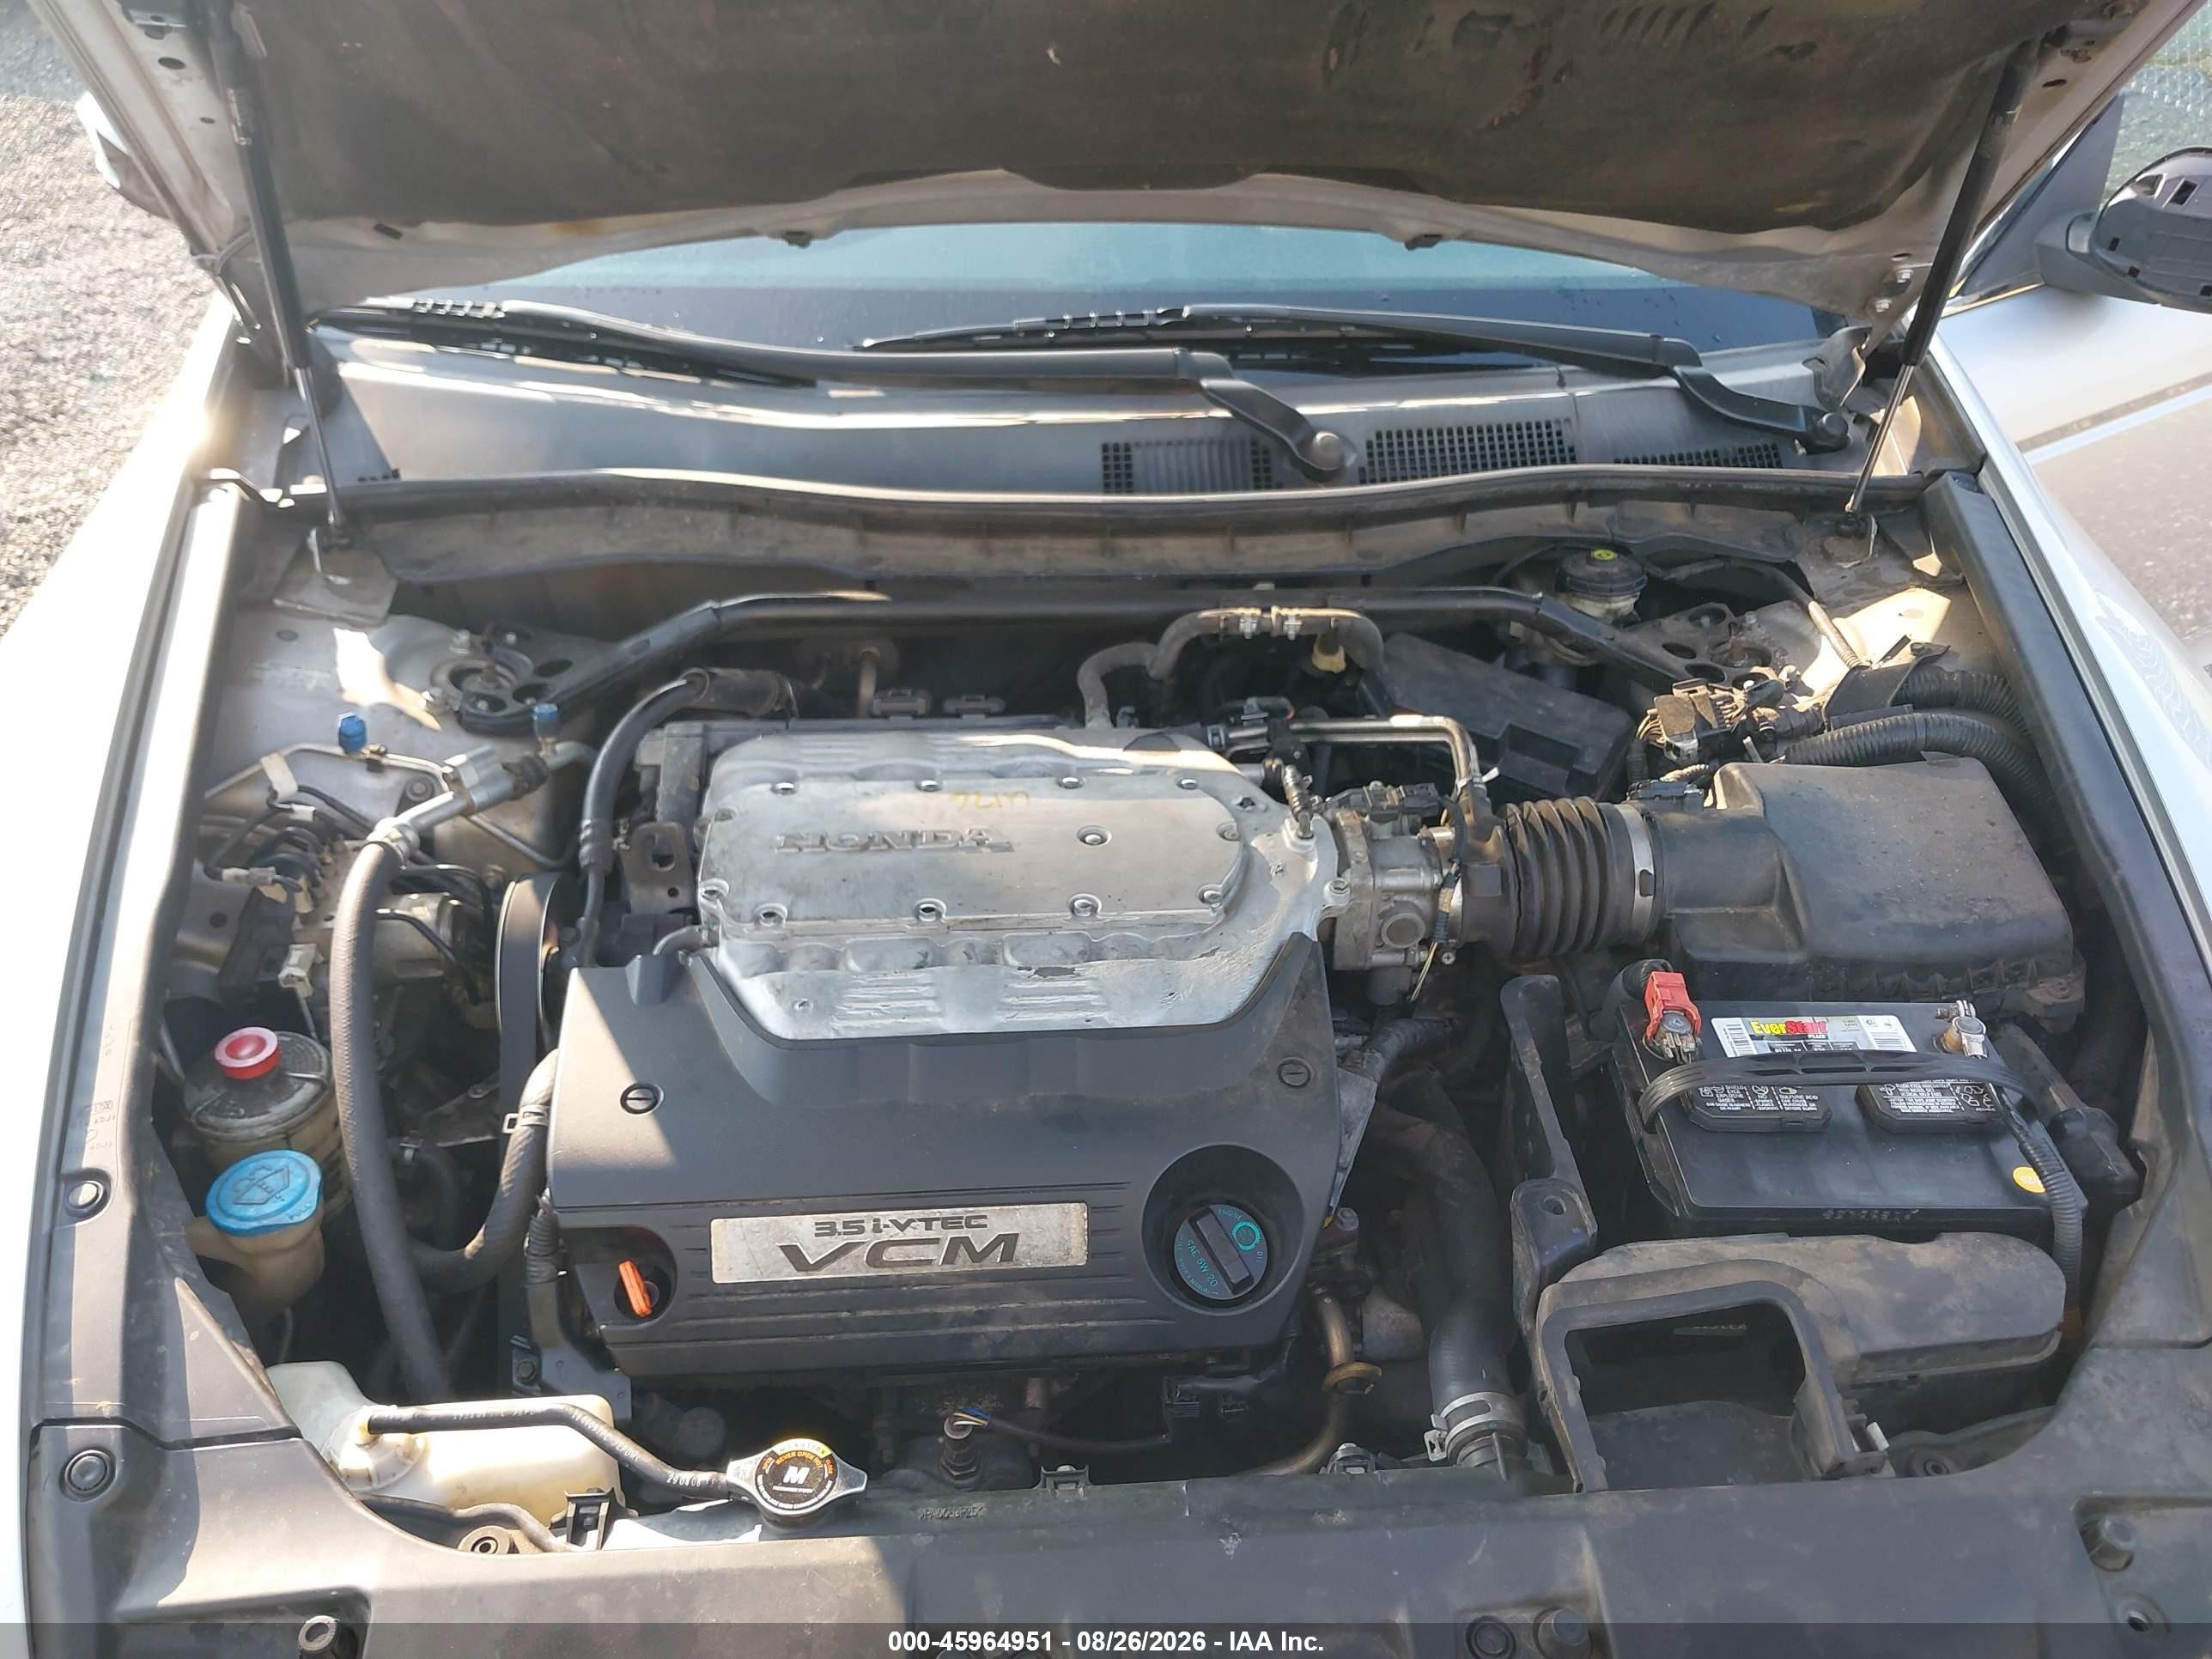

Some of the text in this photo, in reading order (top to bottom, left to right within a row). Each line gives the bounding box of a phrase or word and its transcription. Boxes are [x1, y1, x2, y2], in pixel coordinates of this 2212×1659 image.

[775, 827, 1015, 853] HONDA
[1749, 1020, 1827, 1035] EverStart
[814, 1214, 988, 1237] 3.5 i-VTEC
[777, 1232, 1019, 1273] VCM
[1188, 1239, 1199, 1258] SAE
[775, 1452, 796, 1465] NEVER
[797, 1451, 814, 1460] OPEN
